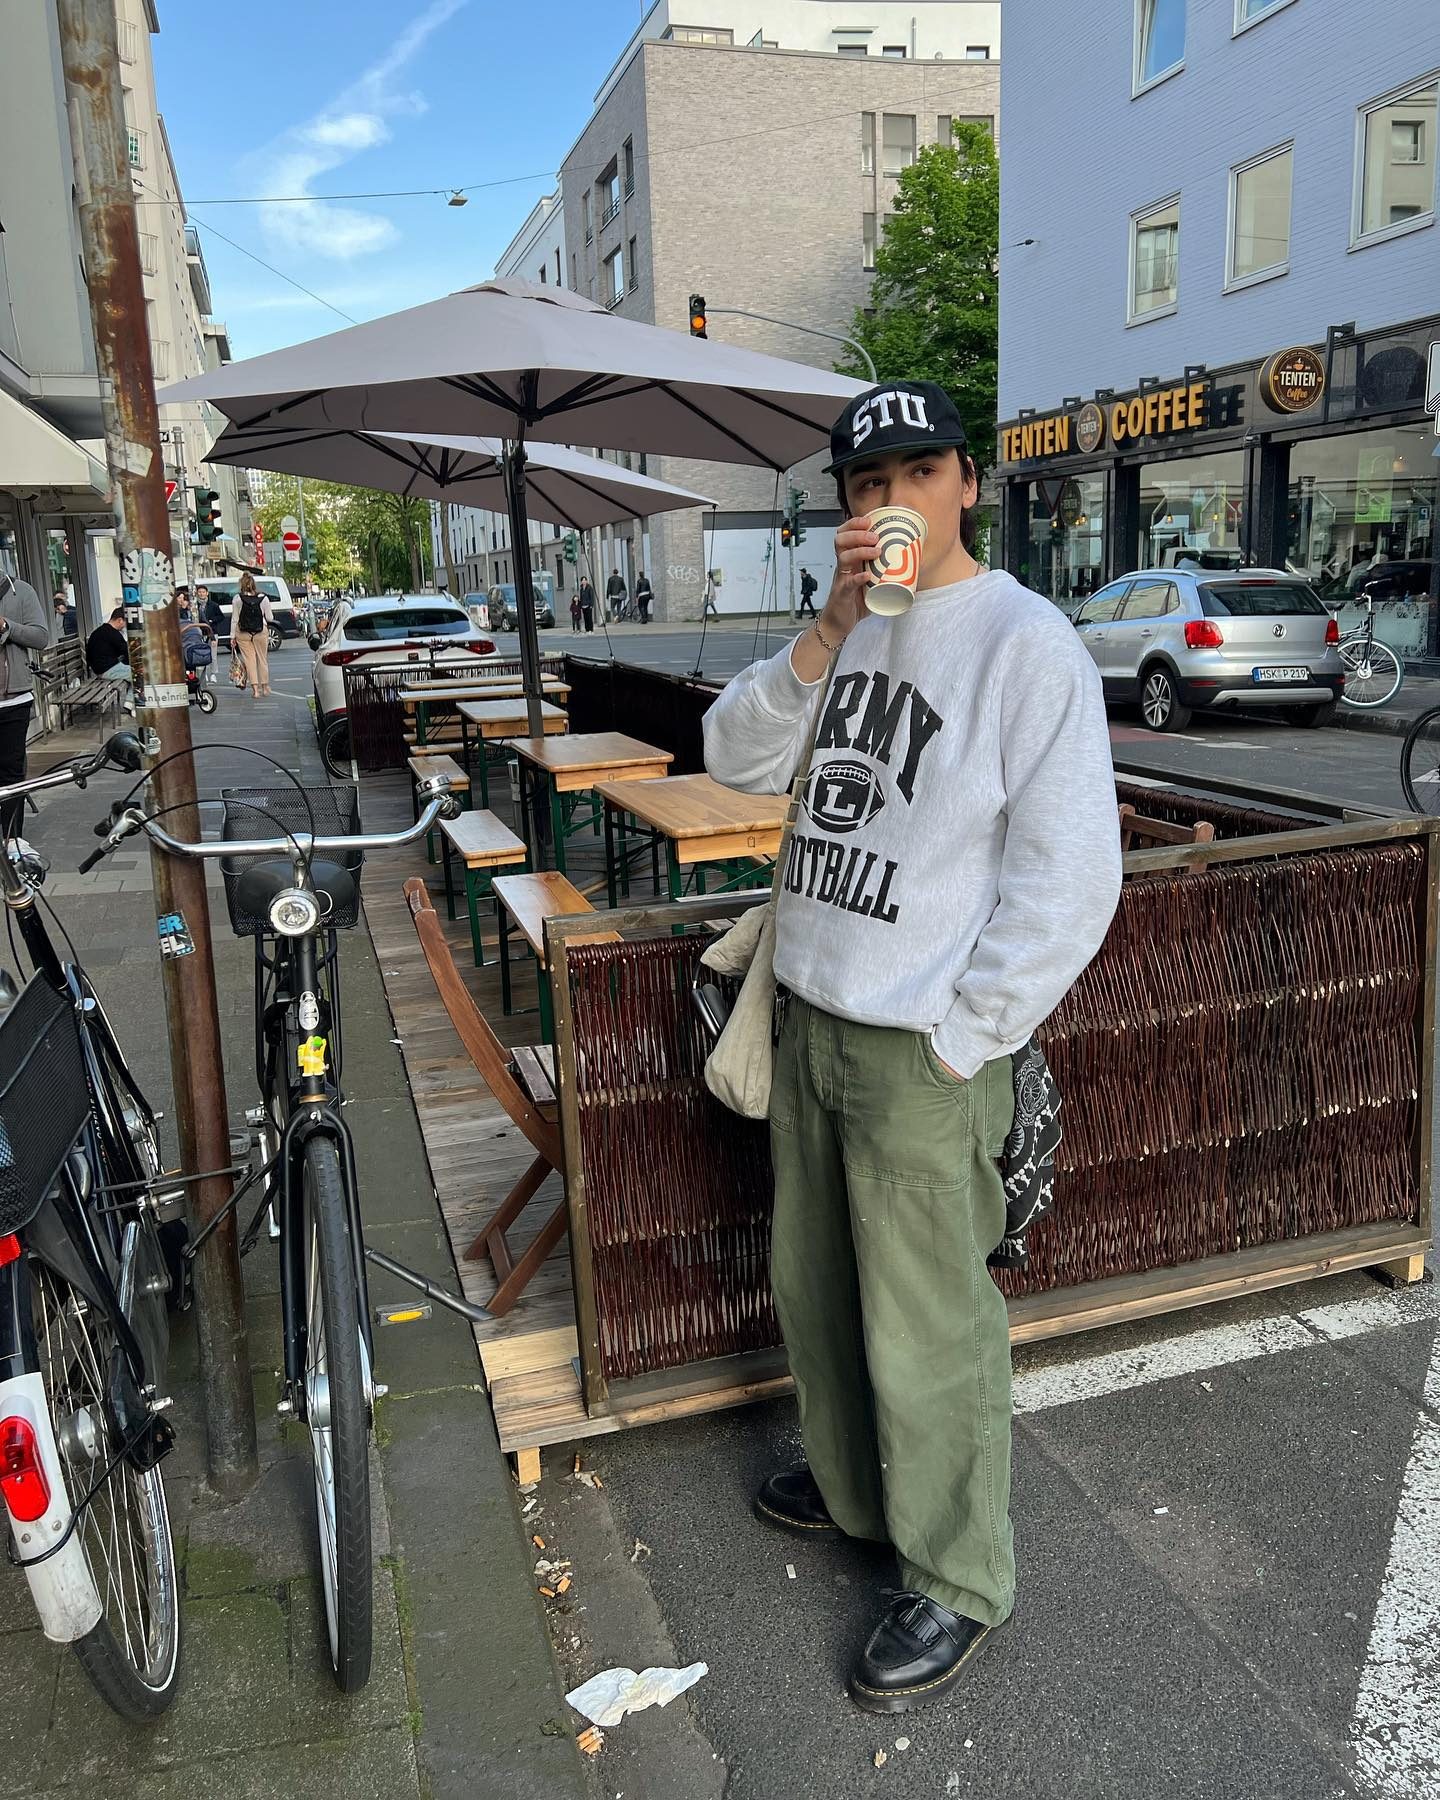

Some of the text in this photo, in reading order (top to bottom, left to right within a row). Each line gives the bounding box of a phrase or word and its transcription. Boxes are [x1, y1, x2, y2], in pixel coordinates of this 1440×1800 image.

[1280, 371, 1316, 387] TENTEN
[1286, 387, 1308, 401] Coffee
[1002, 384, 1206, 462] TENTEN COFFEE
[1260, 669, 1306, 679] HSK P 219
[815, 670, 944, 806] RMY
[821, 784, 857, 818] L
